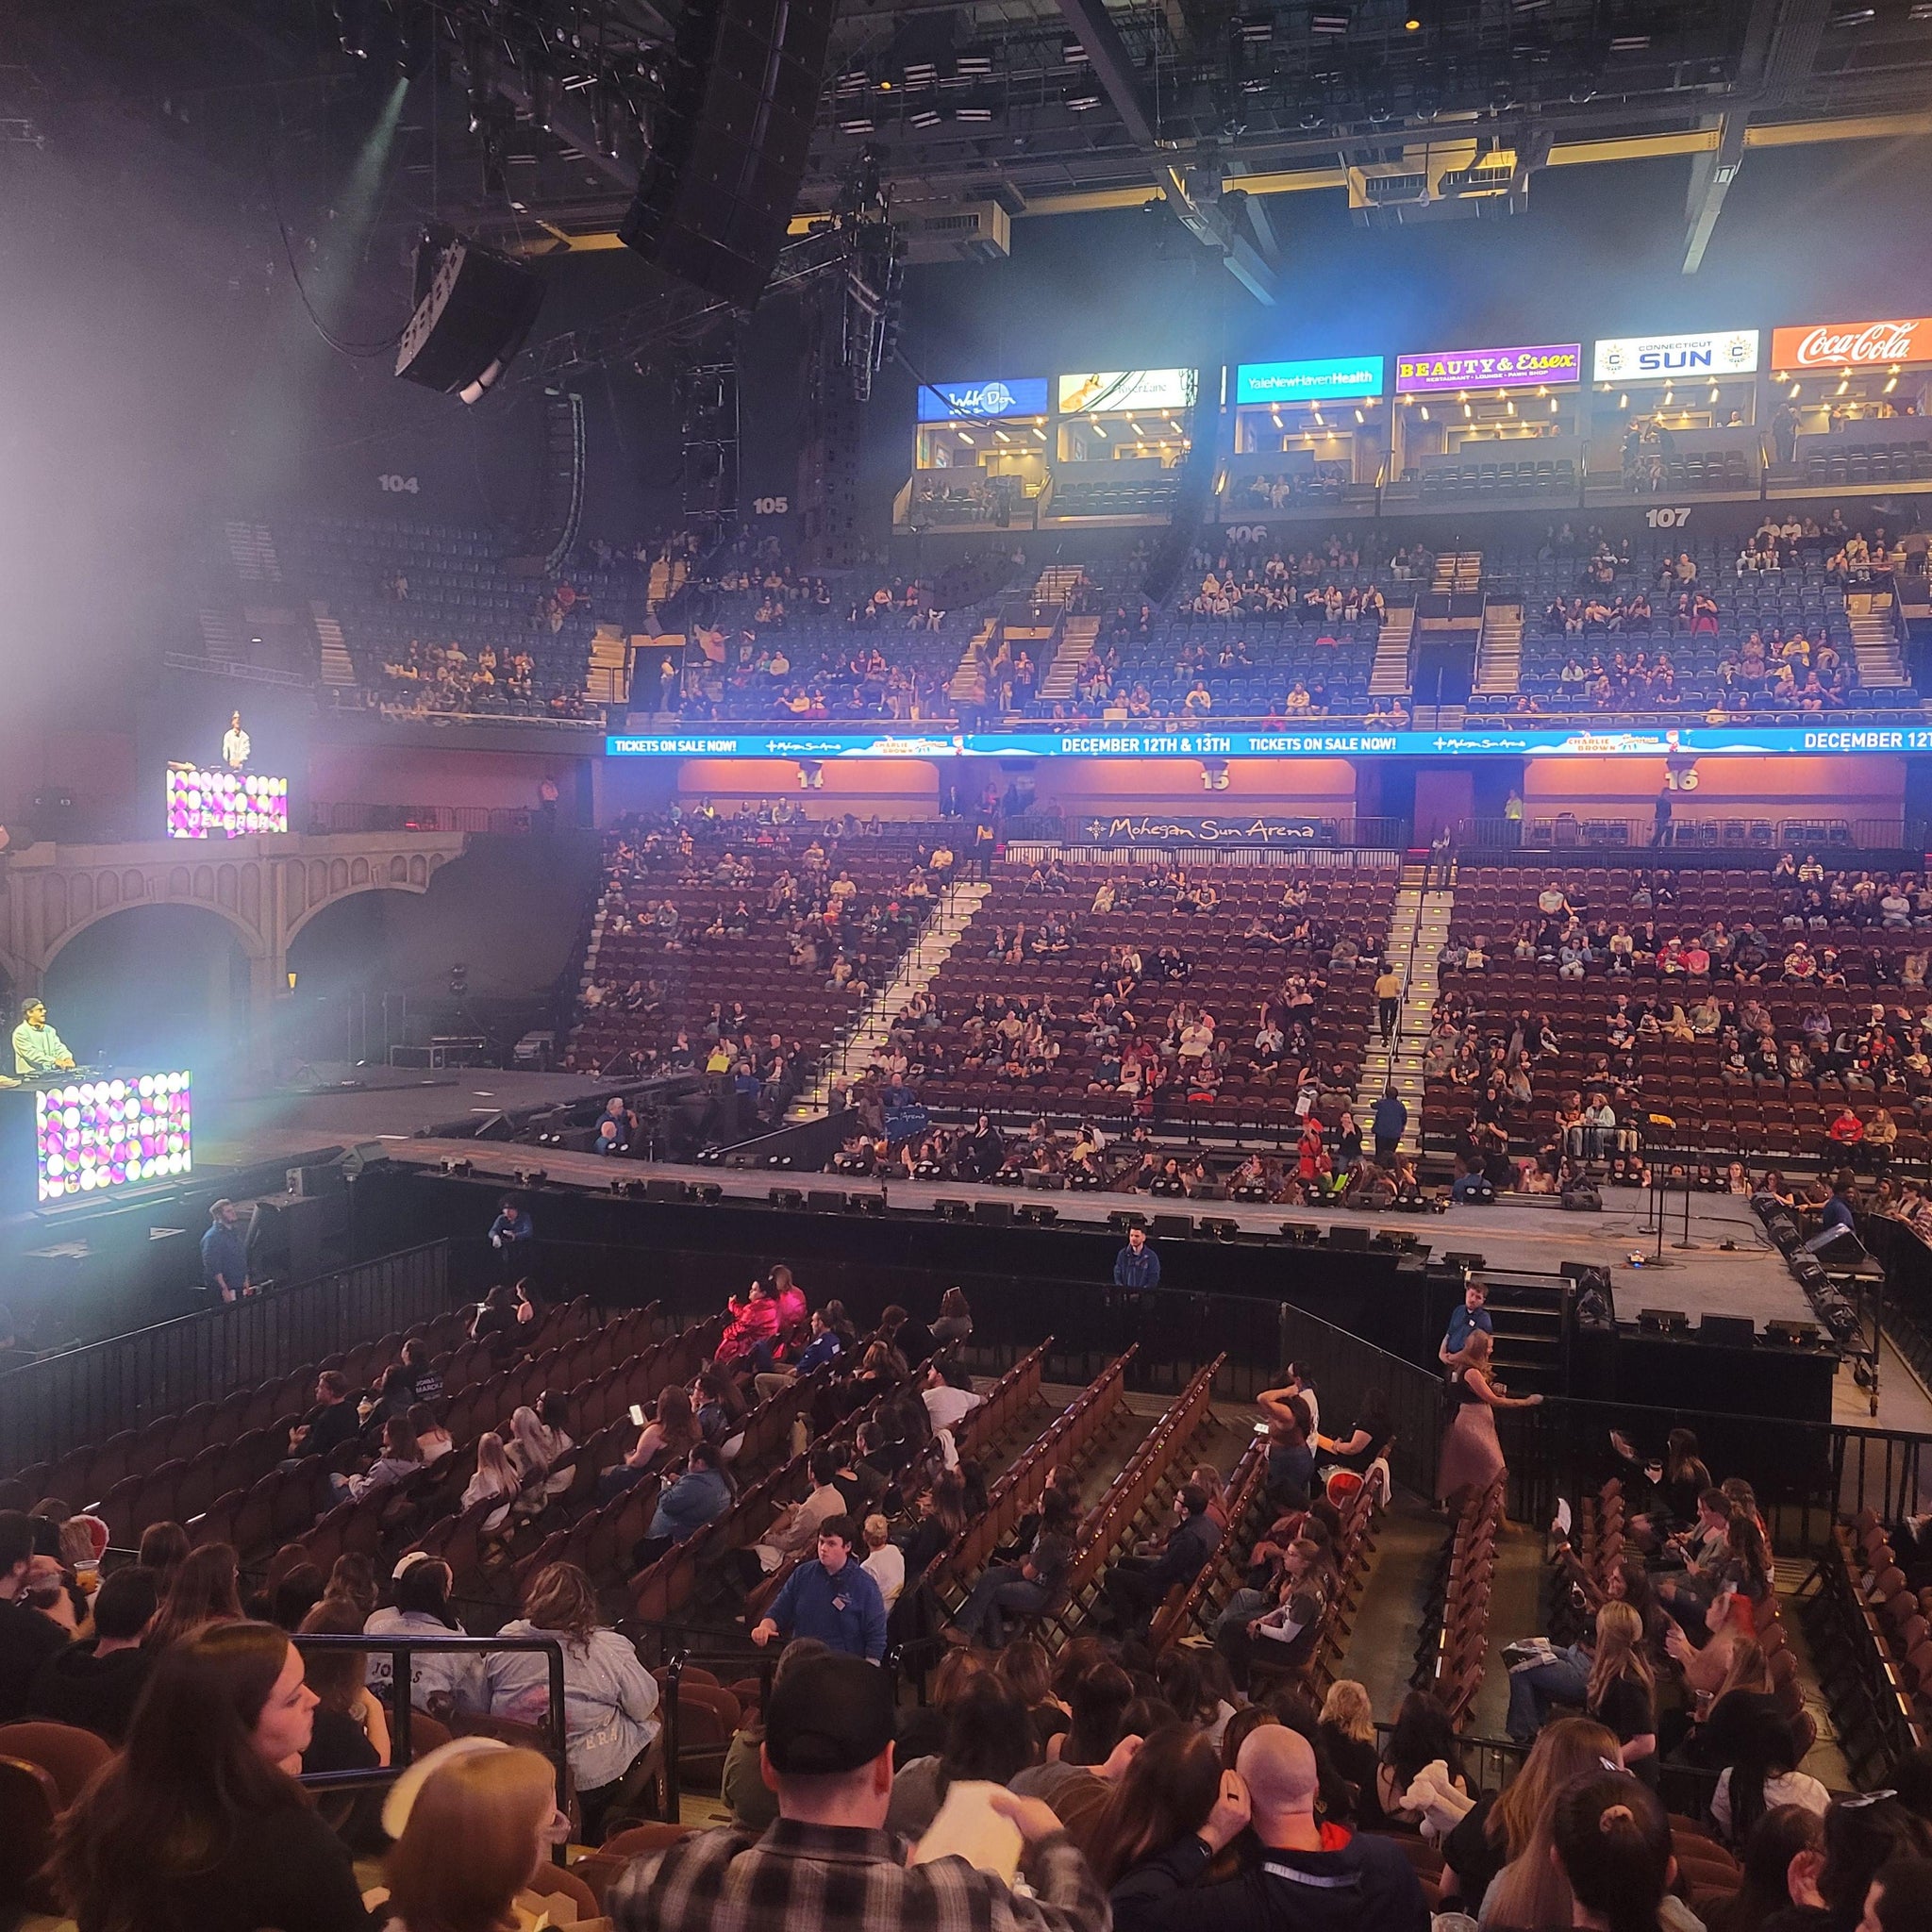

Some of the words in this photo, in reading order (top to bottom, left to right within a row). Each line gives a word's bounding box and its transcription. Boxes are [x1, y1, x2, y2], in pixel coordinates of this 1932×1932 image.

[1638, 341, 1712, 352] CONNECTICUT
[1797, 322, 1920, 364] Coca-Cola
[1400, 358, 1496, 377] BEAUTY
[1496, 356, 1514, 372] &
[1639, 350, 1712, 370] SUN
[1425, 375, 1472, 383] RESTAURANT
[948, 390, 985, 407] Wolf
[377, 474, 421, 494] 104
[753, 496, 789, 514] 105
[1645, 508, 1691, 528] 107
[615, 740, 659, 753] TICKETS
[660, 740, 677, 753] ON
[677, 740, 707, 753] SALE
[707, 740, 738, 753] NOW!
[1061, 738, 1141, 753] DECEMBER
[1142, 738, 1178, 752] 12TH
[1180, 738, 1192, 752] &
[1195, 737, 1231, 752] 13TH
[1248, 738, 1302, 751] TICKETS
[1303, 738, 1323, 751] ON
[1324, 737, 1358, 750] SALE
[1360, 737, 1397, 750] NOW!
[1804, 733, 1904, 748] DECEMBER
[797, 768, 824, 789] 14
[1201, 770, 1230, 790] 15
[1664, 769, 1700, 791] 16
[1109, 817, 1197, 841] Mohegan
[1199, 820, 1243, 841] Sun
[1244, 819, 1316, 842] Arena
[372, 1661, 423, 1684] JOS
[585, 1726, 620, 1751] ERA
